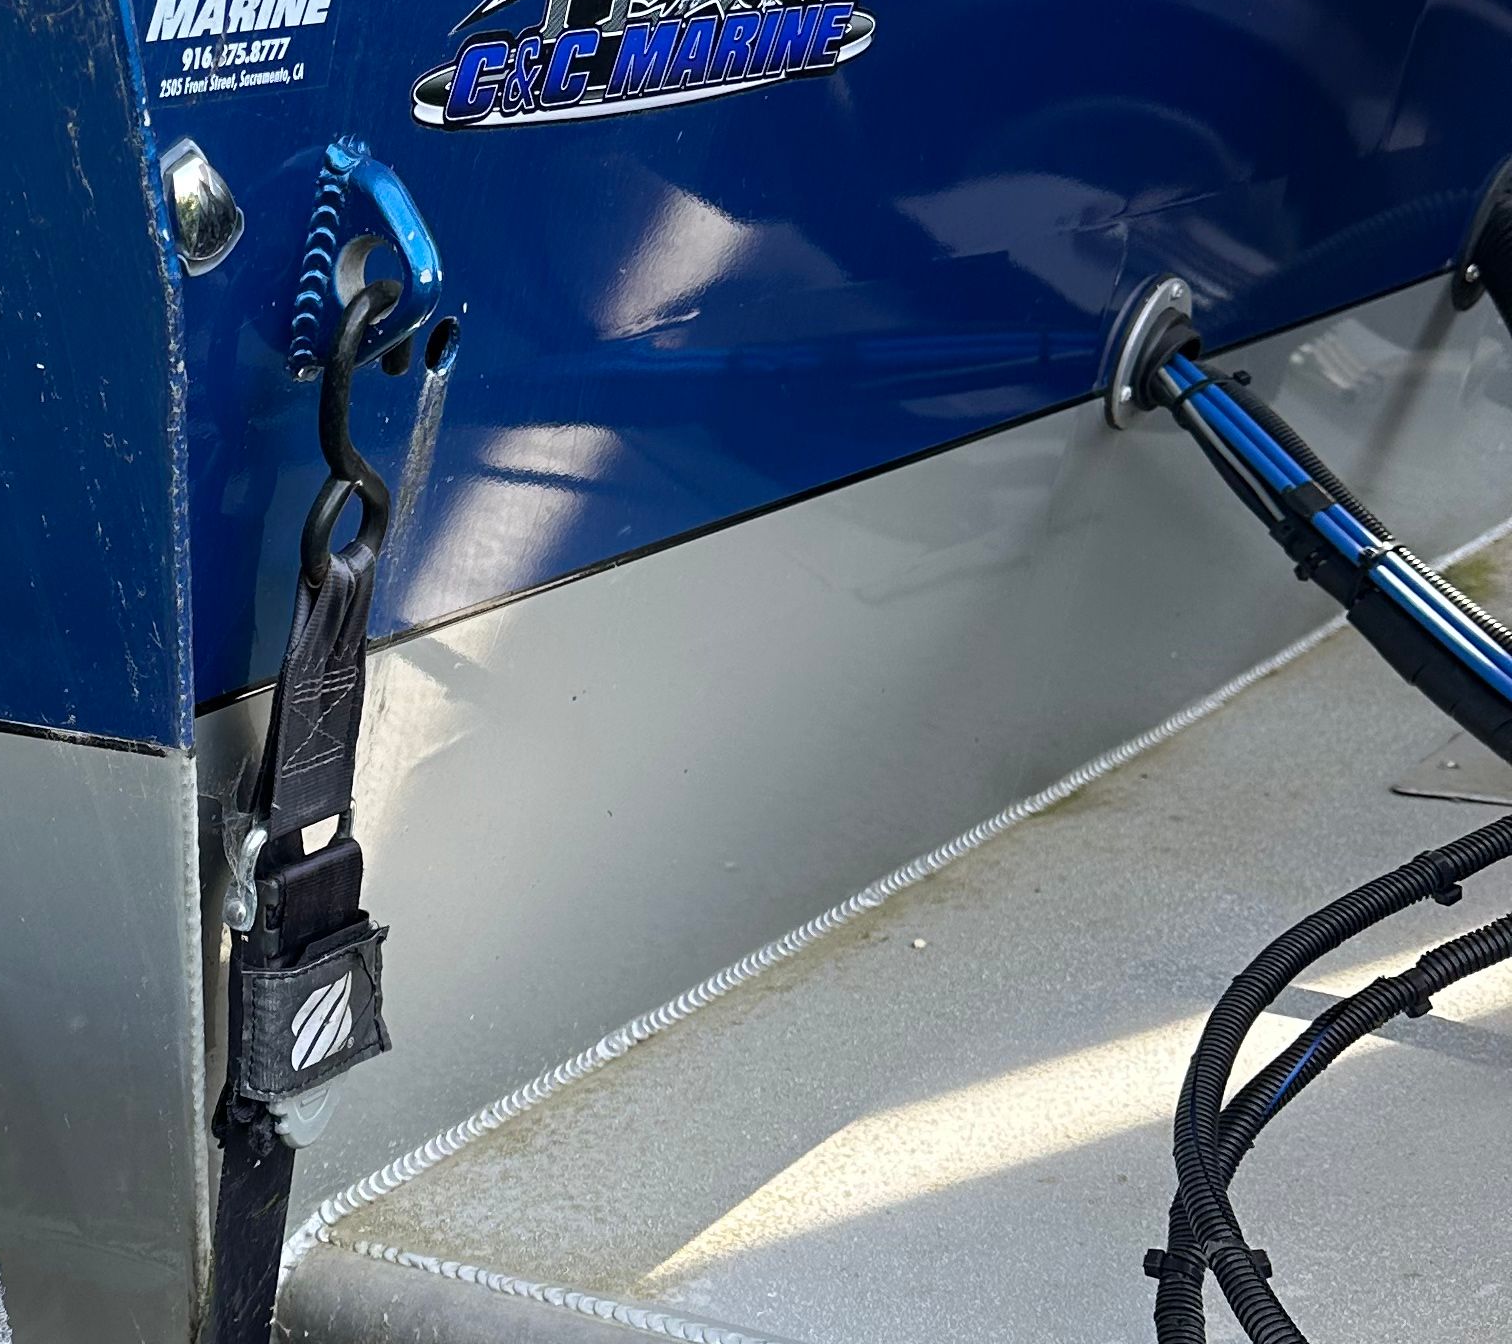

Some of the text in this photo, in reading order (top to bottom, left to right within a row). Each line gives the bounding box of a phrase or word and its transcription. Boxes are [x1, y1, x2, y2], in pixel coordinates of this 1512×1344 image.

[159, 62, 304, 98] 2505 Front Street, Sacramento, CA
[444, 1, 855, 122] C&C MARINE
